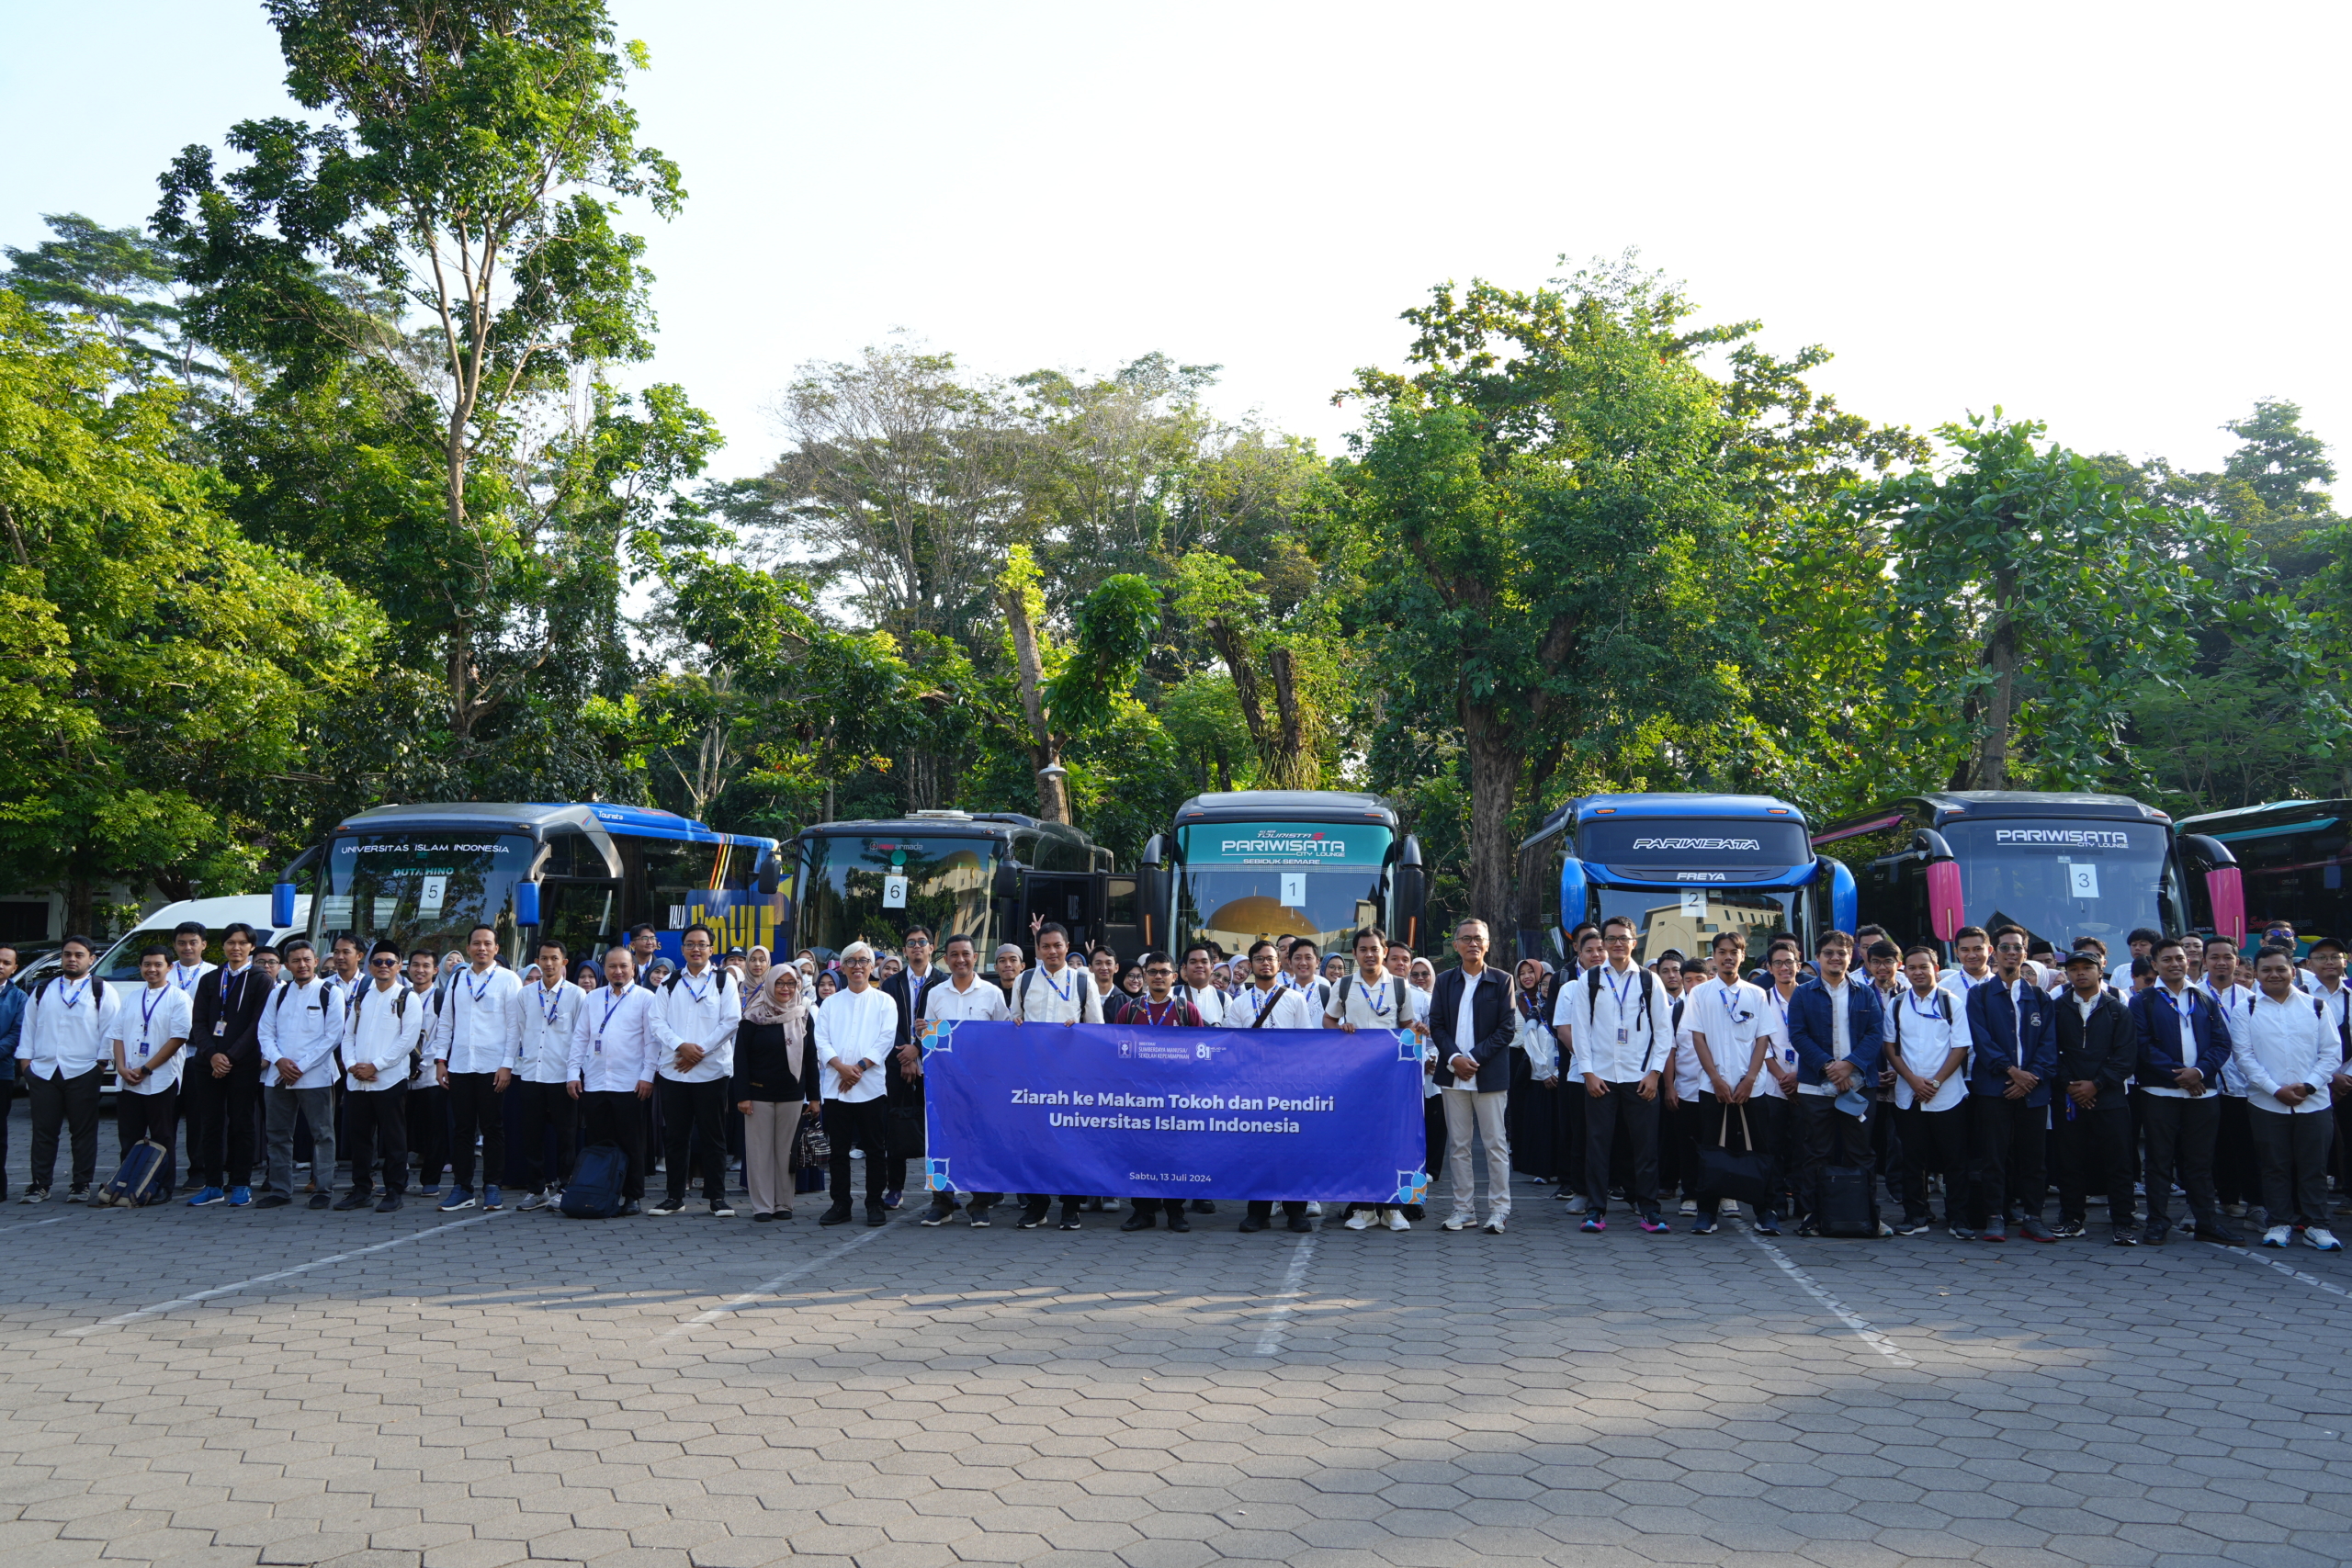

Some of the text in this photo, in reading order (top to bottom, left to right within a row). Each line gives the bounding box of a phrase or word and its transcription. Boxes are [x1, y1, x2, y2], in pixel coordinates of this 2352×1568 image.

[598, 810, 624, 820] Tourista
[1996, 829, 2128, 843] PARIWISATA
[341, 843, 510, 854] UNIVERSITAS ISLAM INDONESIA
[895, 842, 923, 851] armada
[1221, 840, 1345, 852] PARIWISATA
[1633, 838, 1760, 851] PARIWISATA
[392, 866, 455, 876] DUTA HINO
[1677, 872, 1726, 881] FREYA
[2078, 873, 2090, 888] 3
[427, 885, 438, 899] 5
[890, 885, 900, 899] 6
[1288, 882, 1296, 897] 1
[1688, 892, 1700, 908] 2
[1195, 1042, 1212, 1061] 81
[1011, 1089, 1335, 1111] Ziarah ke Makam Tokoh dan Pendiri
[1049, 1111, 1300, 1134] Universitas Islam Indonesia
[1129, 1172, 1212, 1182] Sabtu, 13 Juli 2024
